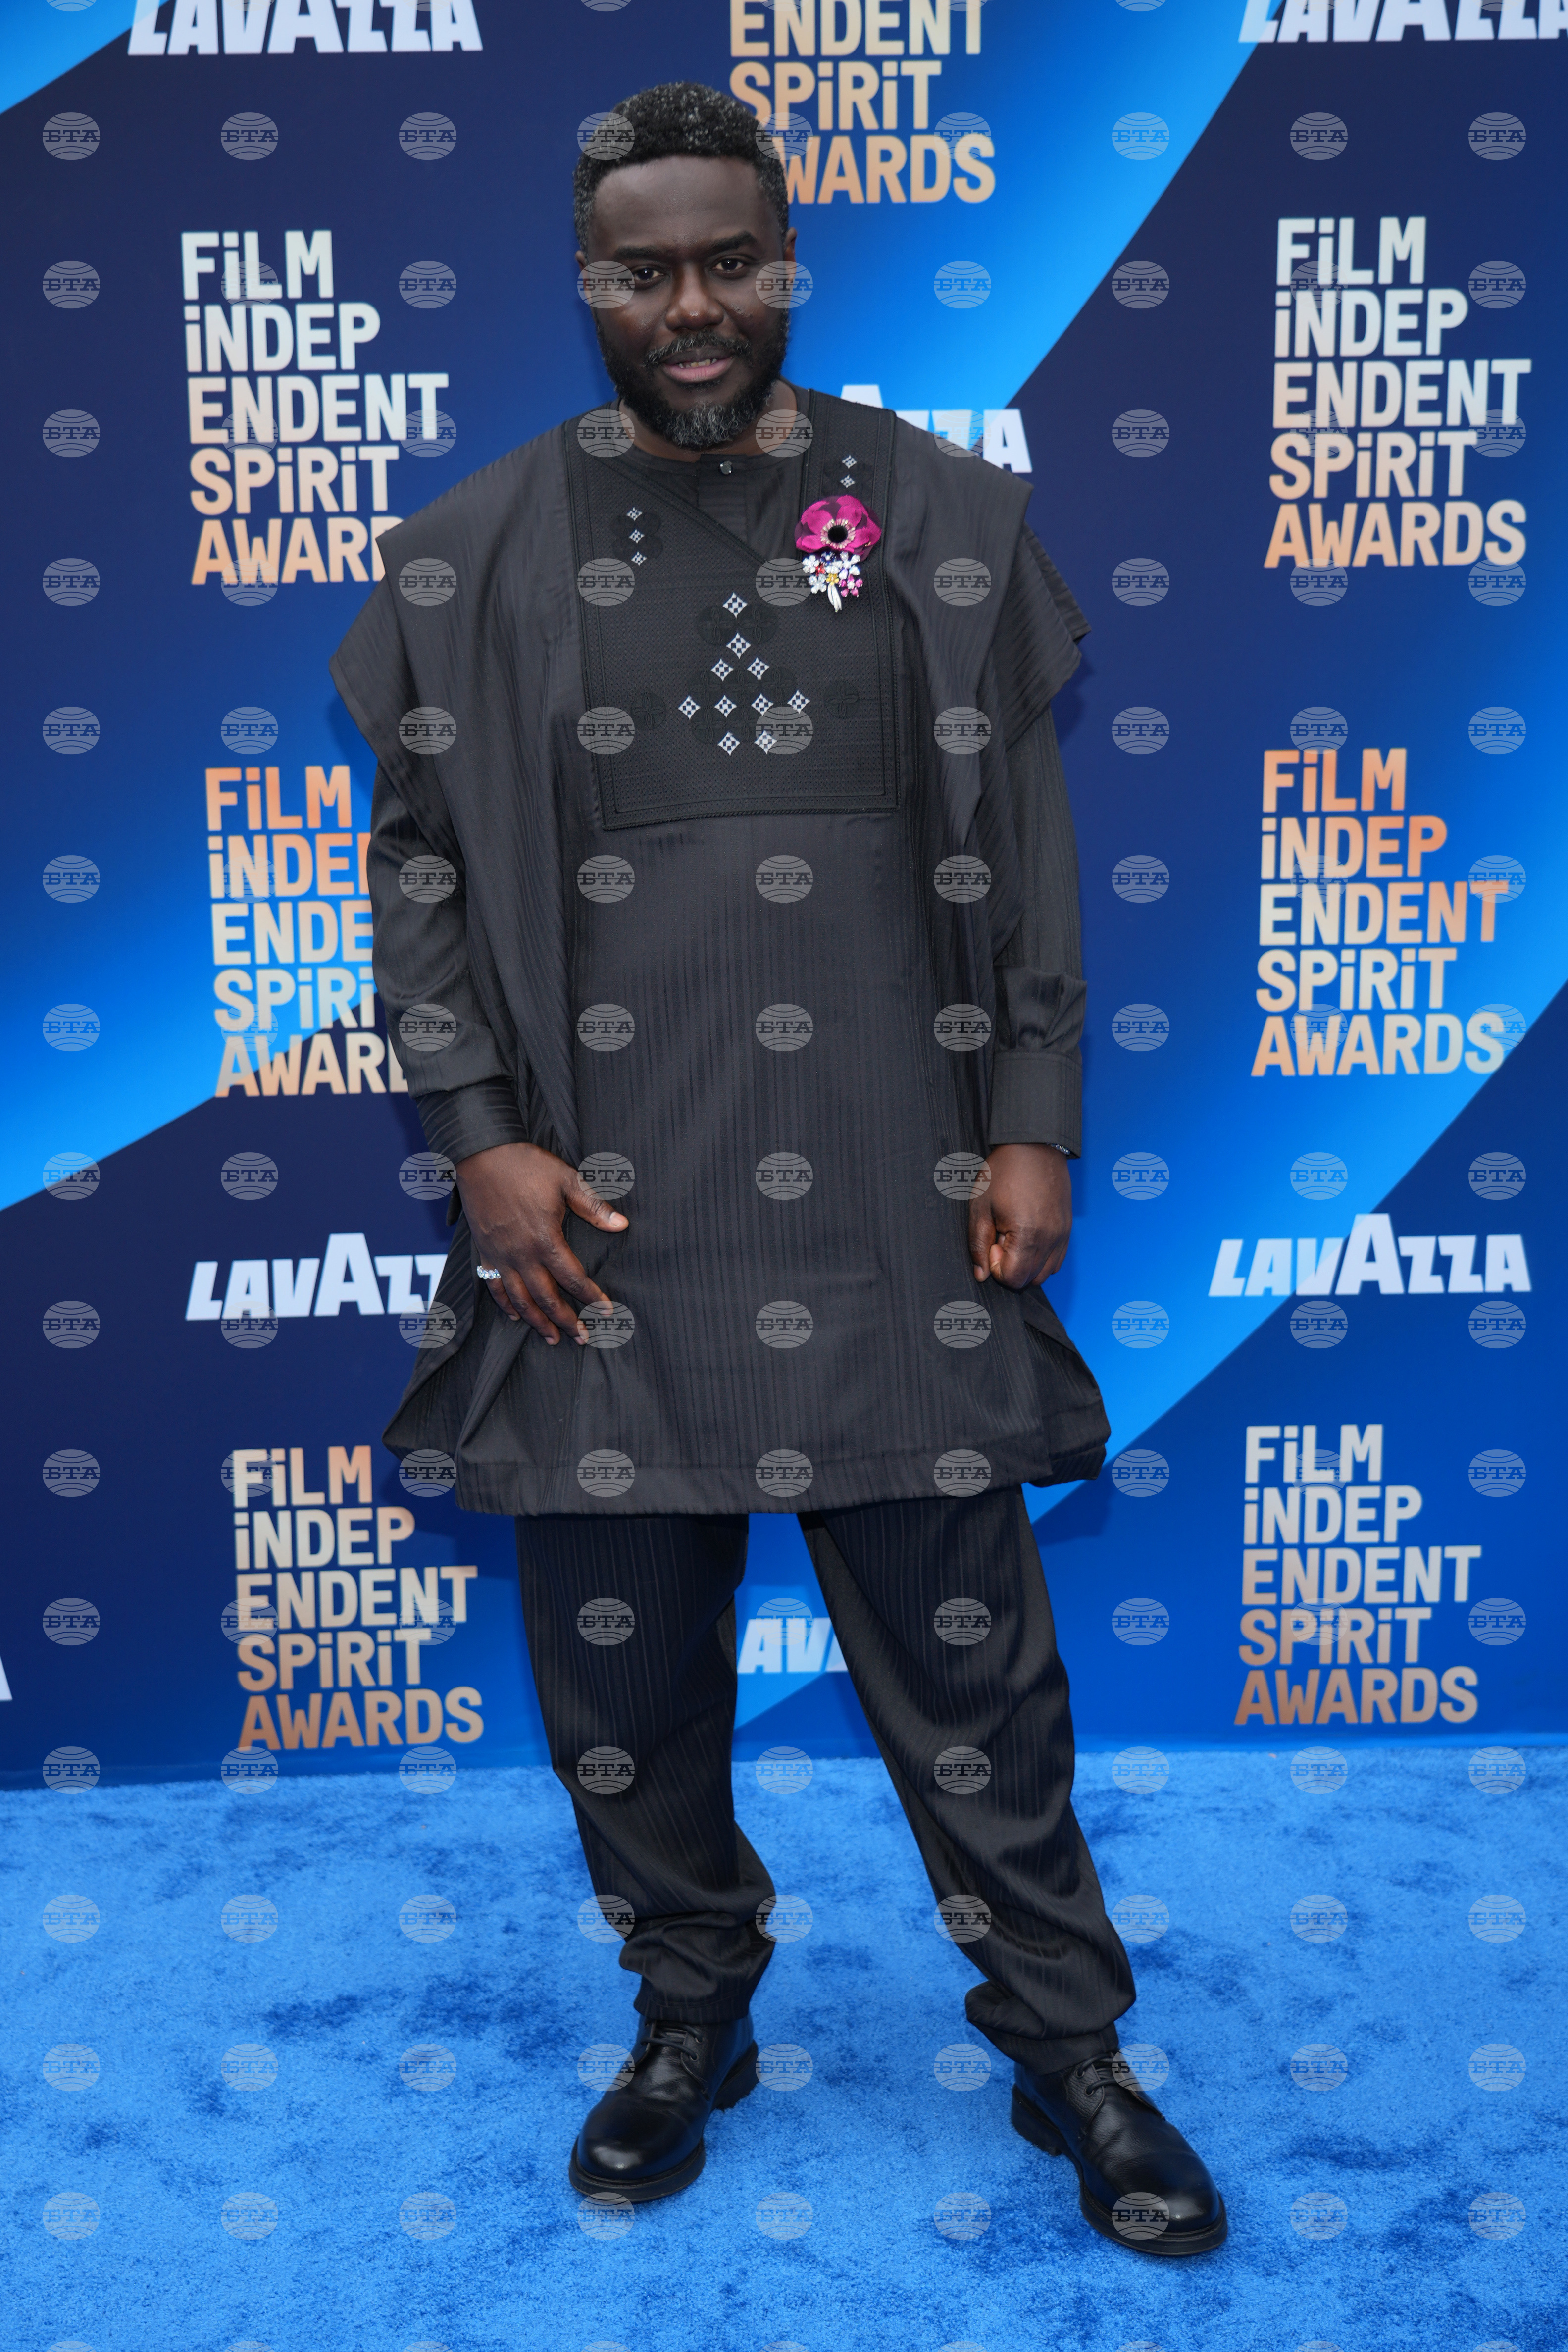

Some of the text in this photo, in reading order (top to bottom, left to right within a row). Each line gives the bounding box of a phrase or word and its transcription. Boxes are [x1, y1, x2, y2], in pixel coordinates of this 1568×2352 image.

[128, 0, 483, 56] LAVAZZA
[730, 0, 993, 57] ENDENT
[771, 133, 996, 204] WARDS
[188, 373, 450, 445] ENDENT
[1272, 359, 1532, 428] ENDENT
[191, 516, 404, 585] AWAR
[1264, 500, 1527, 569] AWARDS
[211, 900, 374, 966] ENDE
[1259, 881, 1509, 946] ENDENT
[213, 966, 376, 1033] SPiRi
[215, 1032, 408, 1098] AWAR
[1251, 1013, 1505, 1077] AWARDS
[185, 1232, 448, 1321] LAVAZ
[1208, 1213, 1532, 1297] LAVAZZA
[236, 1565, 478, 1632] ENDENT
[1241, 1545, 1482, 1606] ENDENT
[238, 1686, 484, 1752] AWARDS
[1234, 1665, 1479, 1726] AWARDS
